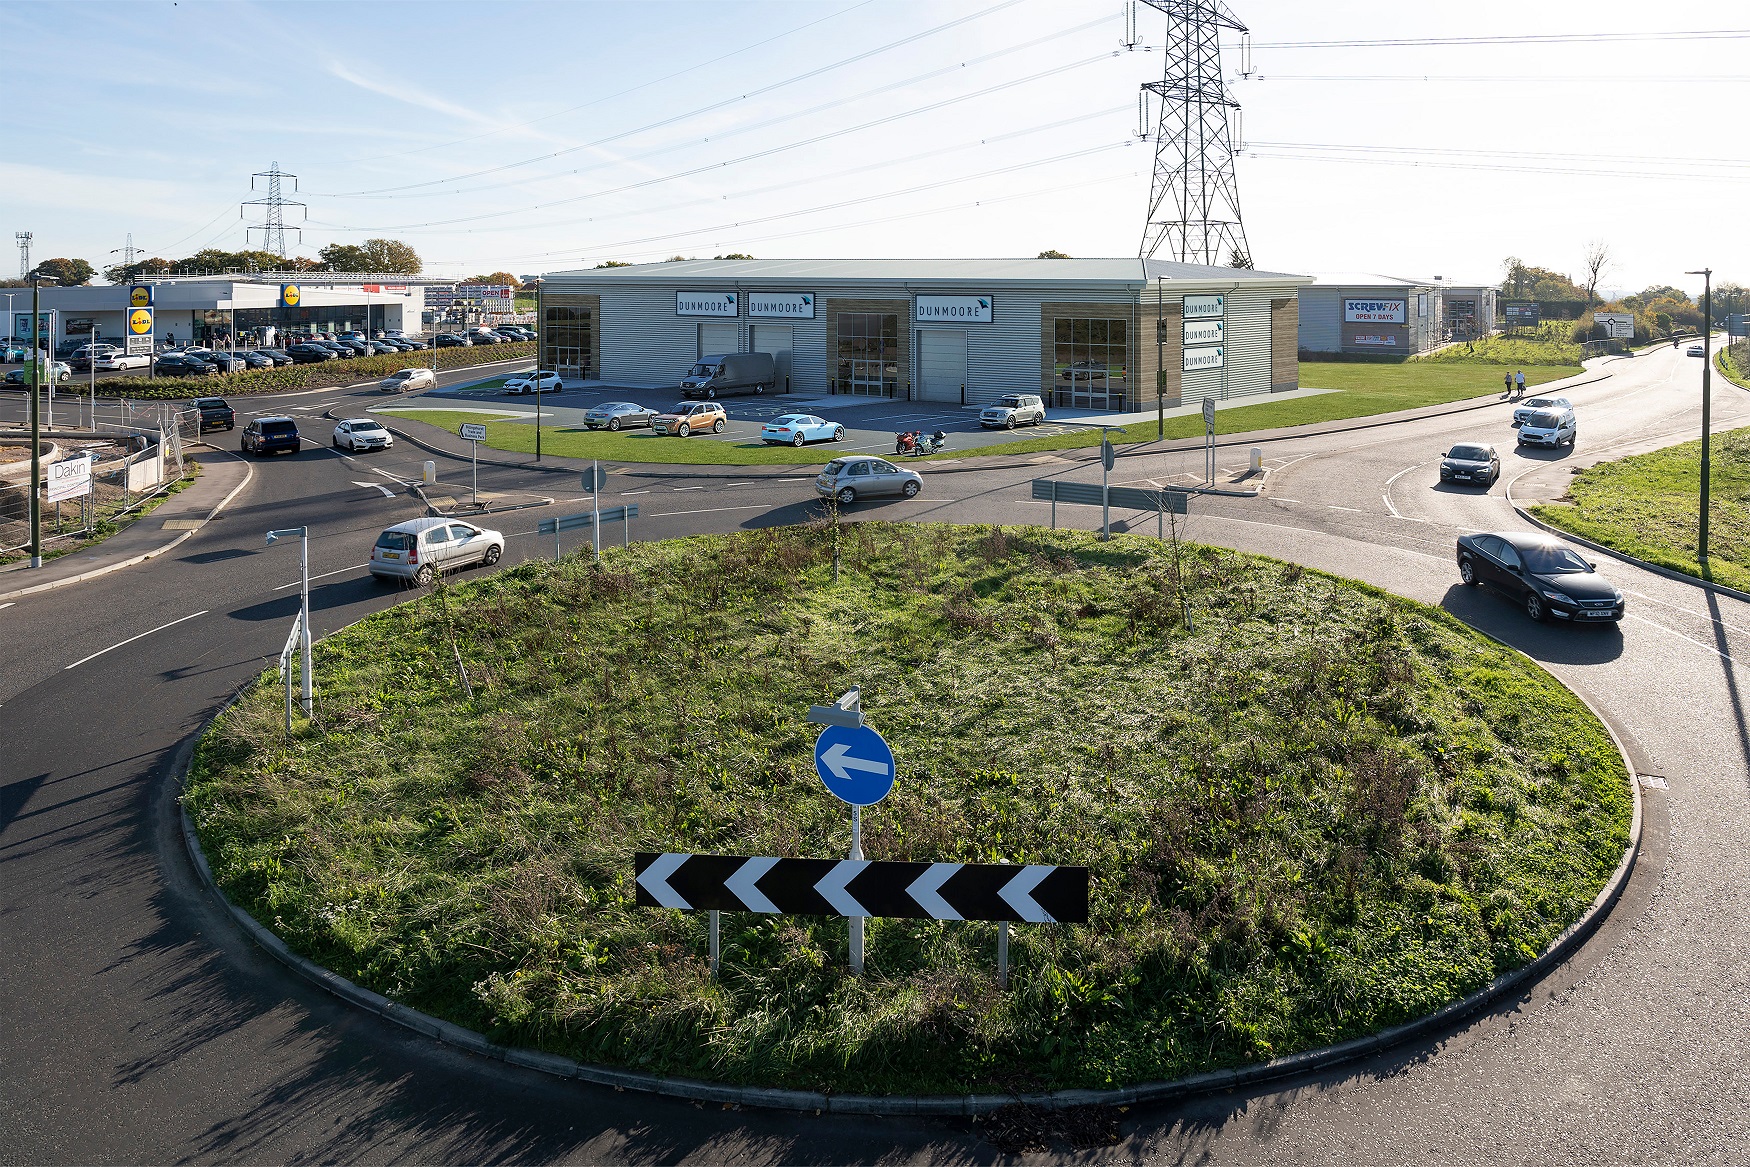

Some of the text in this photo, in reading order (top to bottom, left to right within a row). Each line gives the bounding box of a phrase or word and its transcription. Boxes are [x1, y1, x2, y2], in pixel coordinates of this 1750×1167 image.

[679, 301, 728, 312] DUNMOORE
[751, 302, 803, 313] DUNMOORE
[919, 305, 980, 317] DUNMOORE
[1185, 304, 1218, 314] DUNMOORE
[1348, 302, 1401, 312] SCREWFIX
[1185, 329, 1218, 340] DUNMOORE
[1185, 355, 1218, 367] DUNMOORE
[55, 461, 85, 478] Dakin
